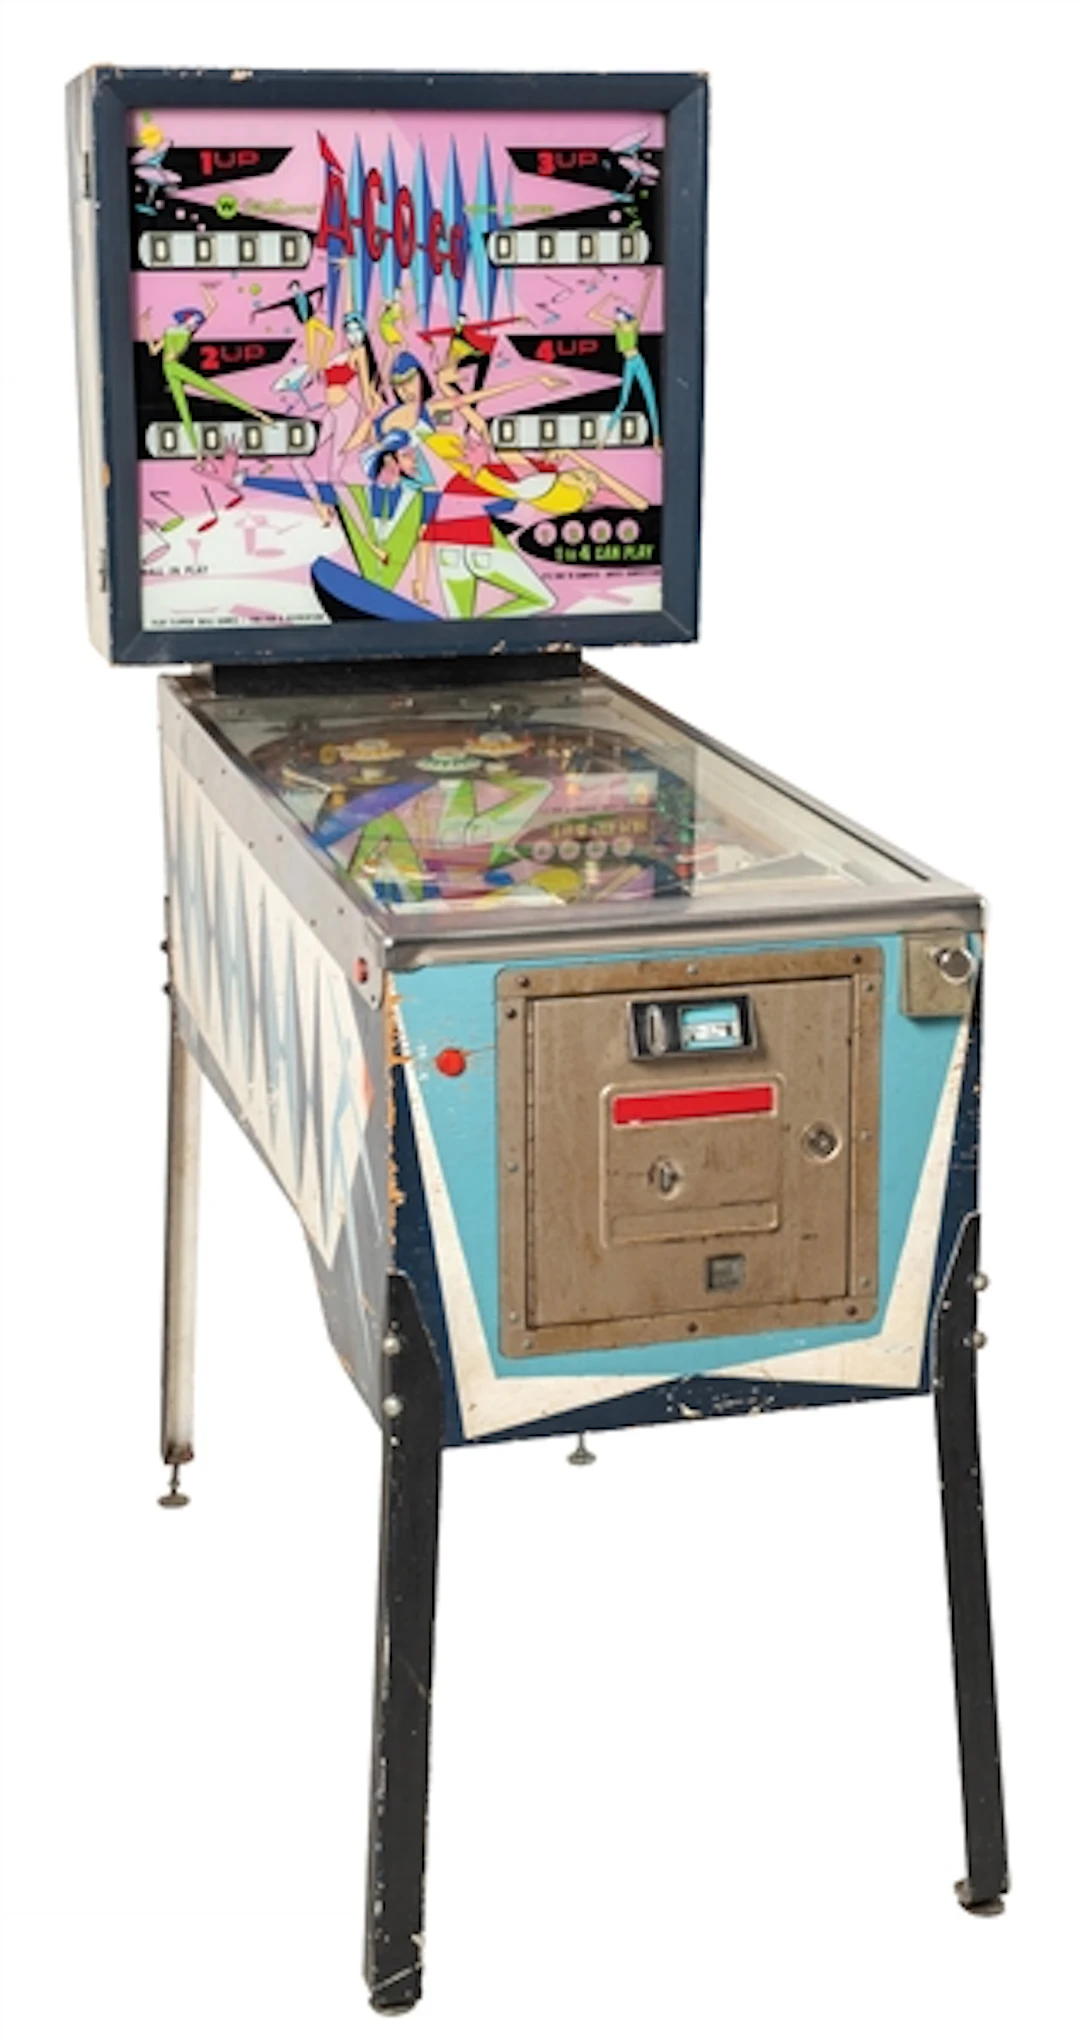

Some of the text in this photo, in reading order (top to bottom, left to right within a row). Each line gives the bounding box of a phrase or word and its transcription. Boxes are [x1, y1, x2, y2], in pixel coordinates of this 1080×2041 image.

[200, 150, 261, 176] 1UP
[536, 150, 599, 177] 3UP
[199, 345, 267, 371] 2UP
[535, 338, 601, 364] 4UP
[623, 542, 656, 561] PLAY
